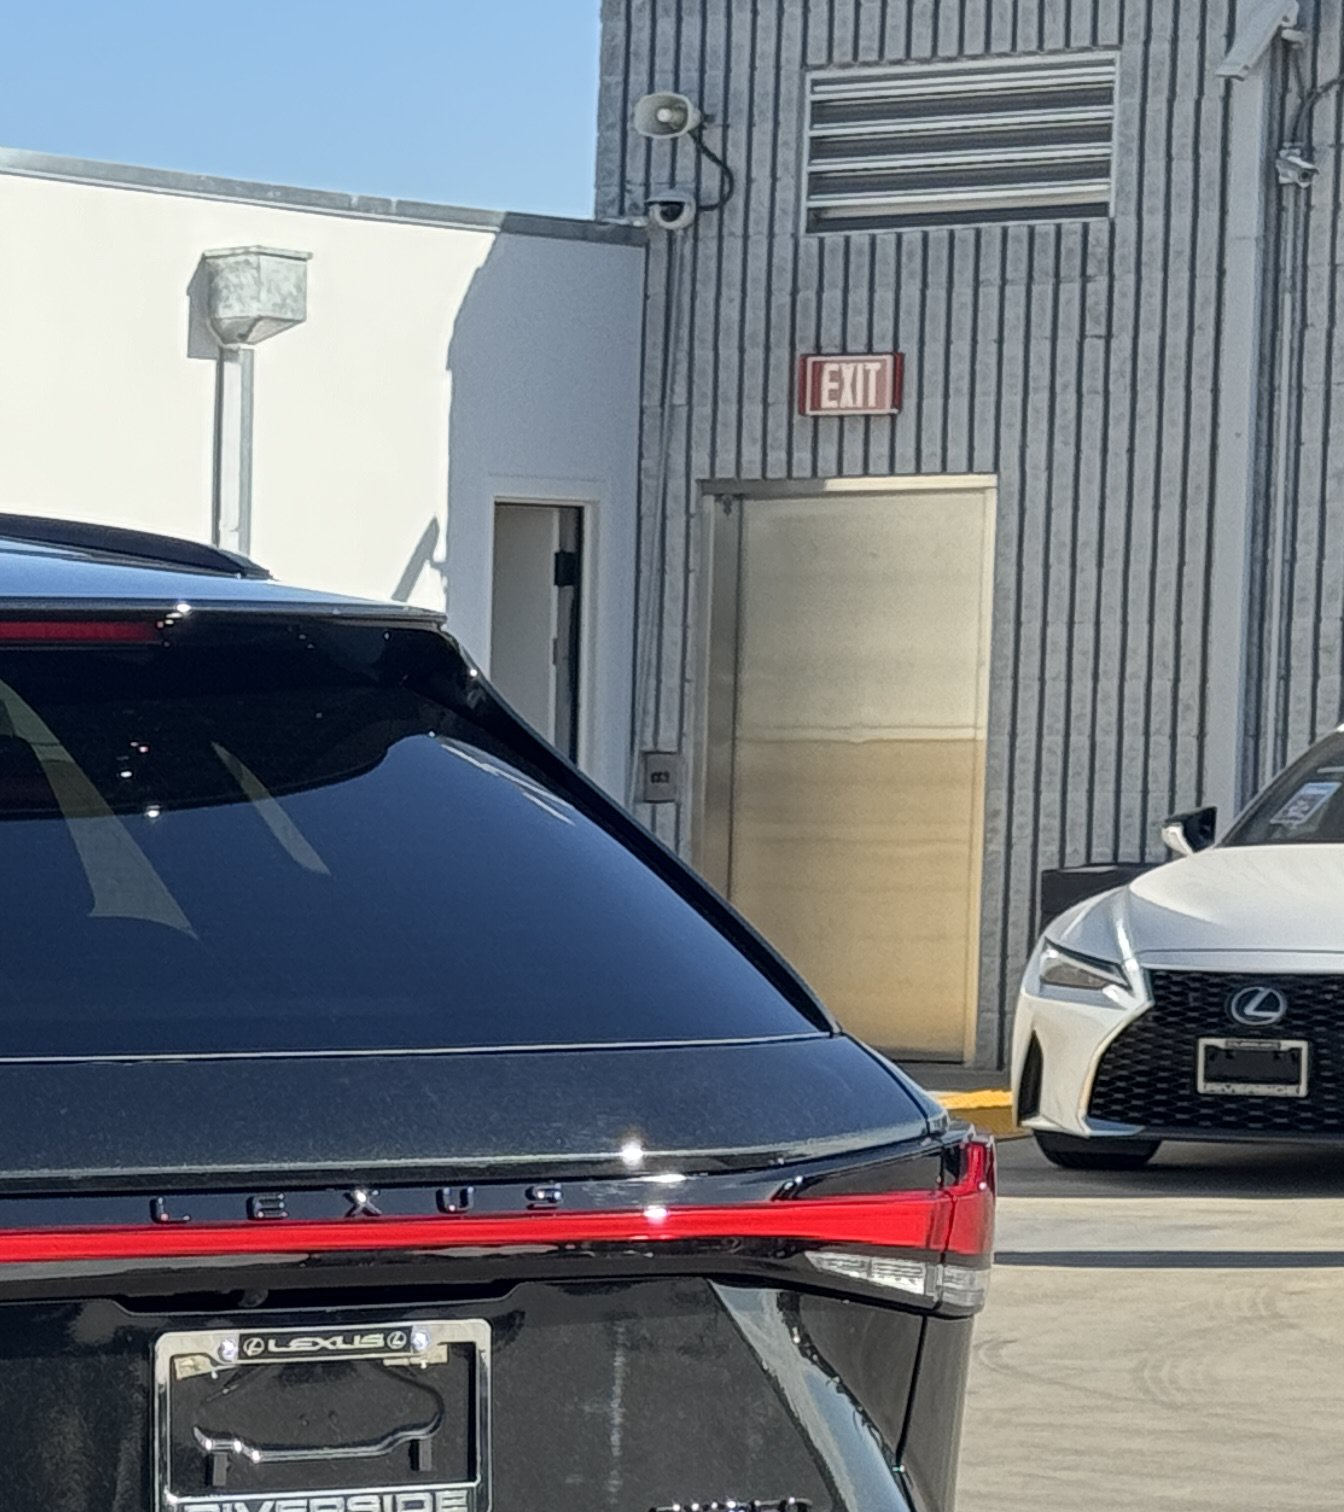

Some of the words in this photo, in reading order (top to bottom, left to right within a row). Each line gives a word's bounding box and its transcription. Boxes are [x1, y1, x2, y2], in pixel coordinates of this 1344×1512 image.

[820, 361, 882, 409] EXIT
[149, 1182, 564, 1223] LEXUS
[267, 1332, 385, 1352] LEXUS
